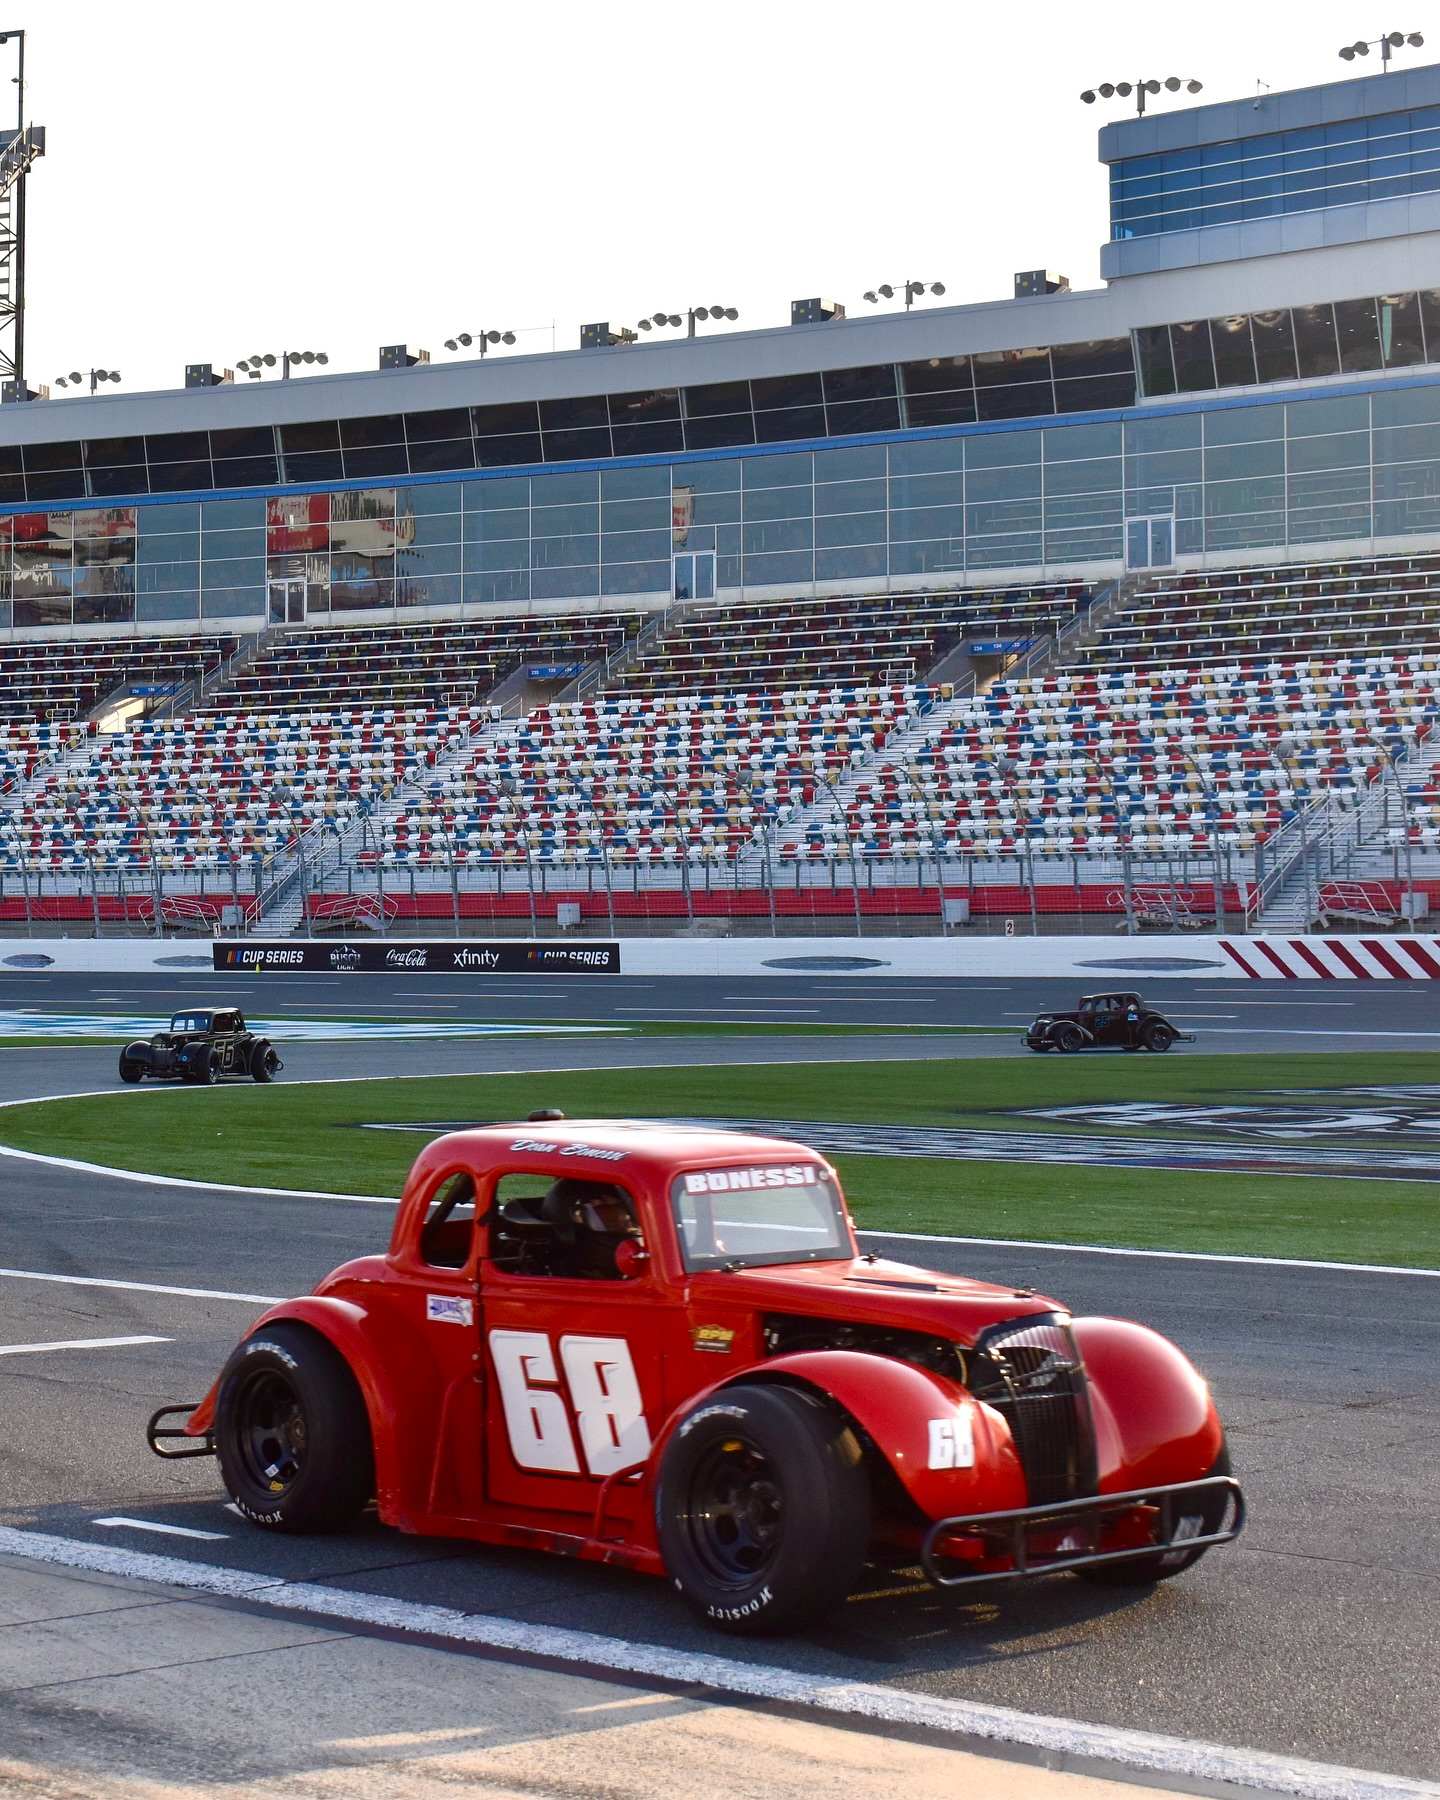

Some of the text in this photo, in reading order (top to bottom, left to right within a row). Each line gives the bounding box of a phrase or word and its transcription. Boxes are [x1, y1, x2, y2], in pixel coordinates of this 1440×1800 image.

[1006, 922, 1013, 935] 2
[242, 950, 304, 963] CUP SERIES
[330, 953, 361, 965] BUSCH
[386, 948, 428, 966] Coca-Cola
[453, 948, 500, 967] xfinity
[568, 951, 610, 965] SERIES
[1095, 1015, 1110, 1028] 25
[509, 1139, 558, 1153] Dean
[684, 1165, 817, 1194] BONESSI
[489, 1329, 651, 1479] 68
[707, 1585, 773, 1620] Hoosier
